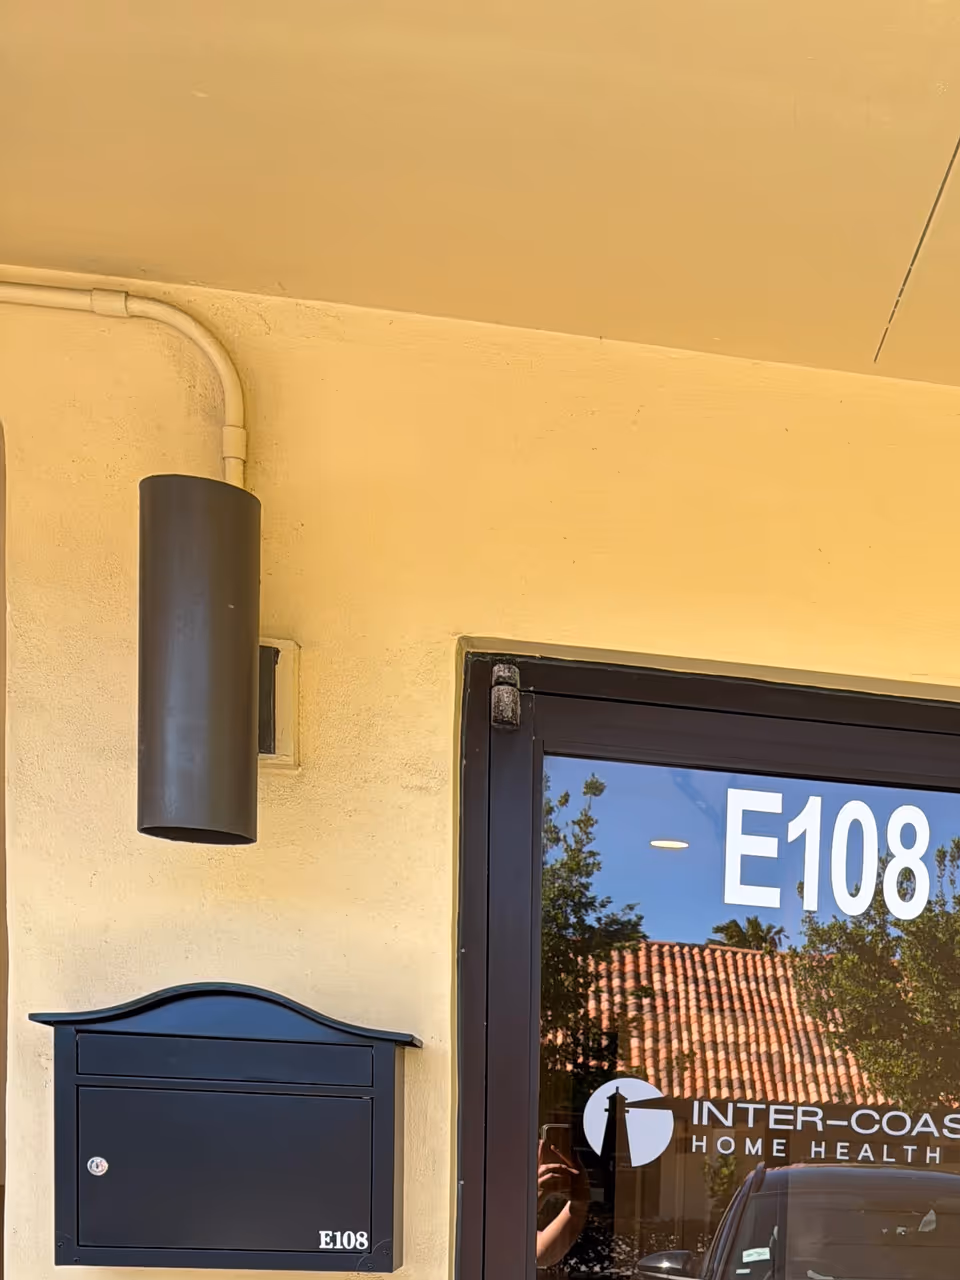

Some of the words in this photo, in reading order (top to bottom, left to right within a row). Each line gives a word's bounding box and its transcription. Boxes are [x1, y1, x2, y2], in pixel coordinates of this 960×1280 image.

[724, 788, 931, 921] E108
[692, 1134, 787, 1158] HOME
[811, 1140, 941, 1165] HEALTH
[318, 1230, 369, 1250] E108
